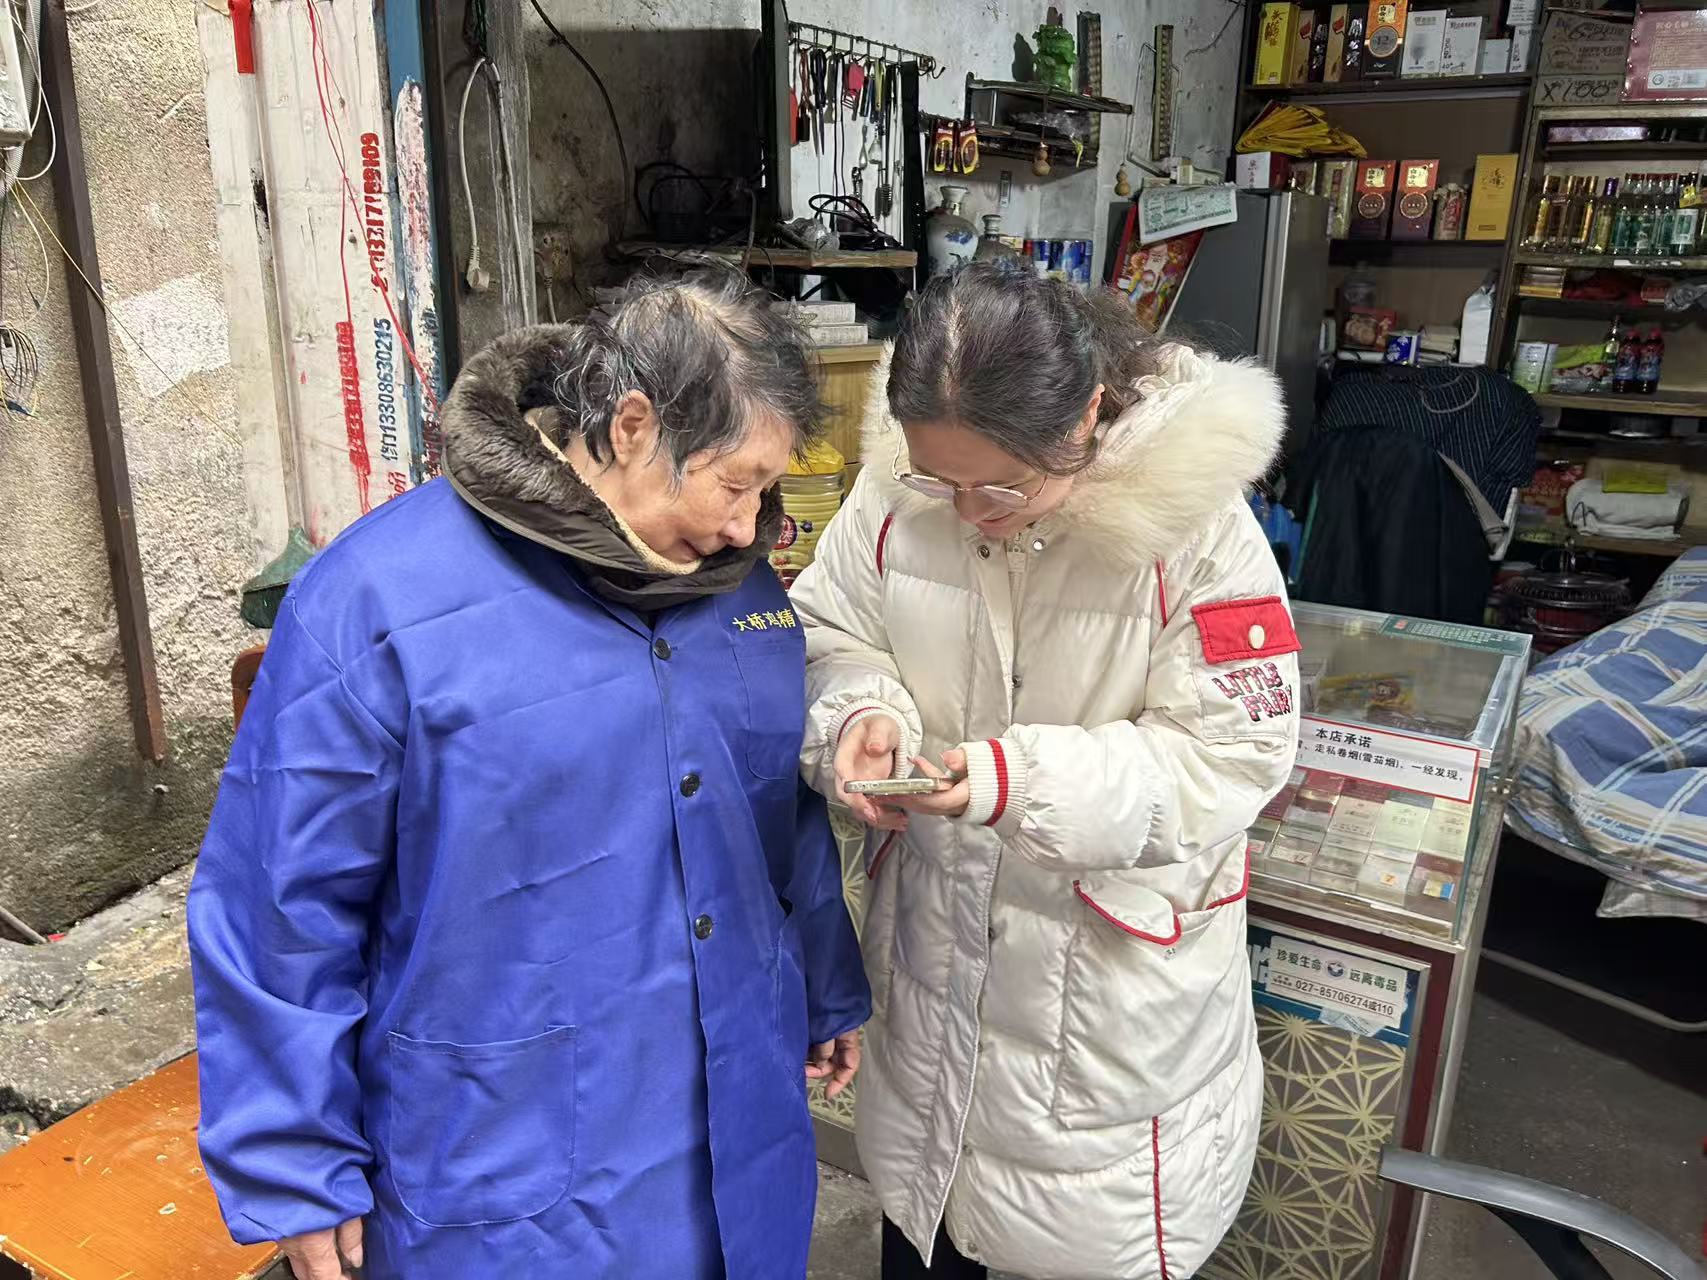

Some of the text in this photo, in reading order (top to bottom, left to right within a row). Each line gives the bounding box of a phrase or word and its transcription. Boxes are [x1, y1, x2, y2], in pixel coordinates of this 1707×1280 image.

[732, 609, 796, 632] 大桥鸡精
[1211, 661, 1284, 700] LITTLE
[1315, 727, 1373, 749] 本店承诺
[1276, 948, 1398, 993] 珍爱生命 远离毒品
[1295, 979, 1394, 1016] 027-85706274或110
